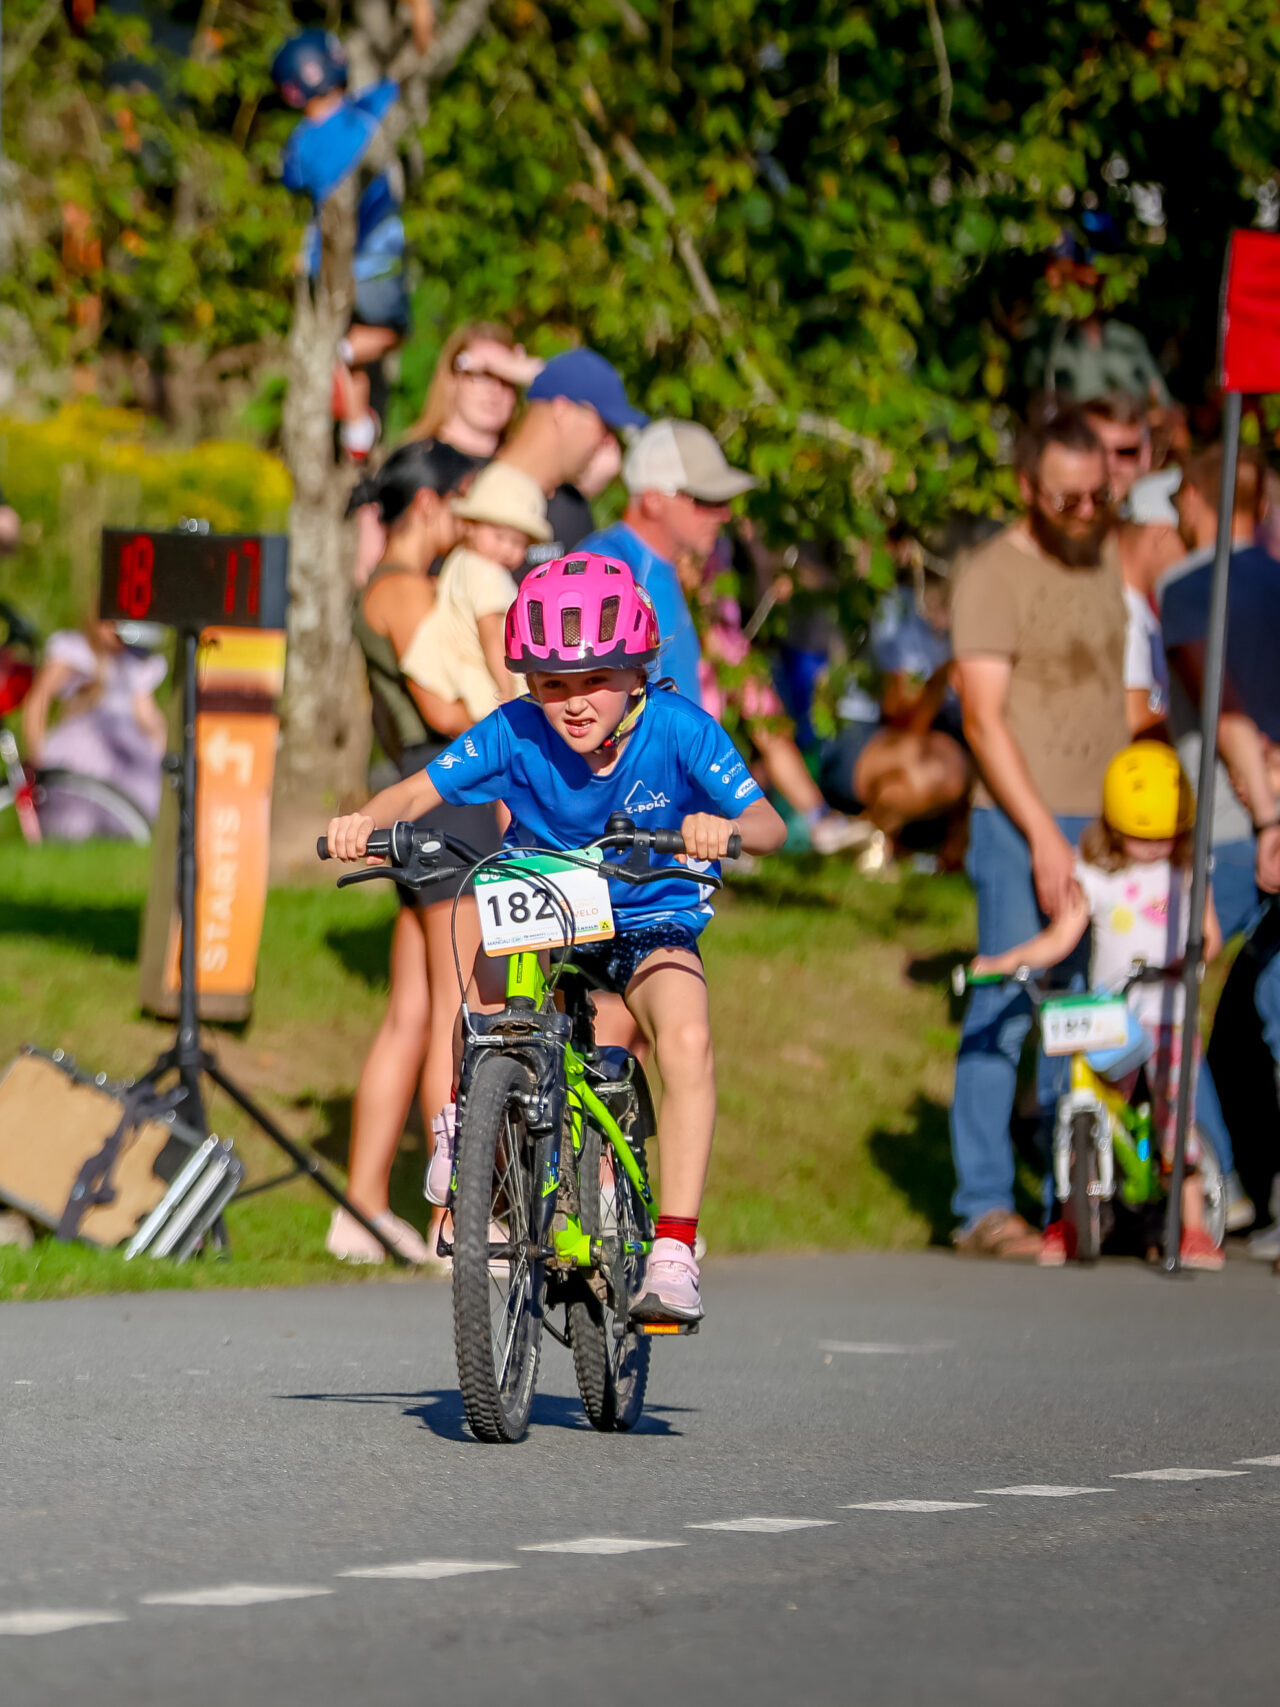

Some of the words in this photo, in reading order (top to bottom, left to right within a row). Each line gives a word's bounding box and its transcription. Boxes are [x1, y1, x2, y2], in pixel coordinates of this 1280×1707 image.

[224, 540, 261, 614] 17
[199, 804, 241, 973] STARTS
[487, 888, 556, 927] 182
